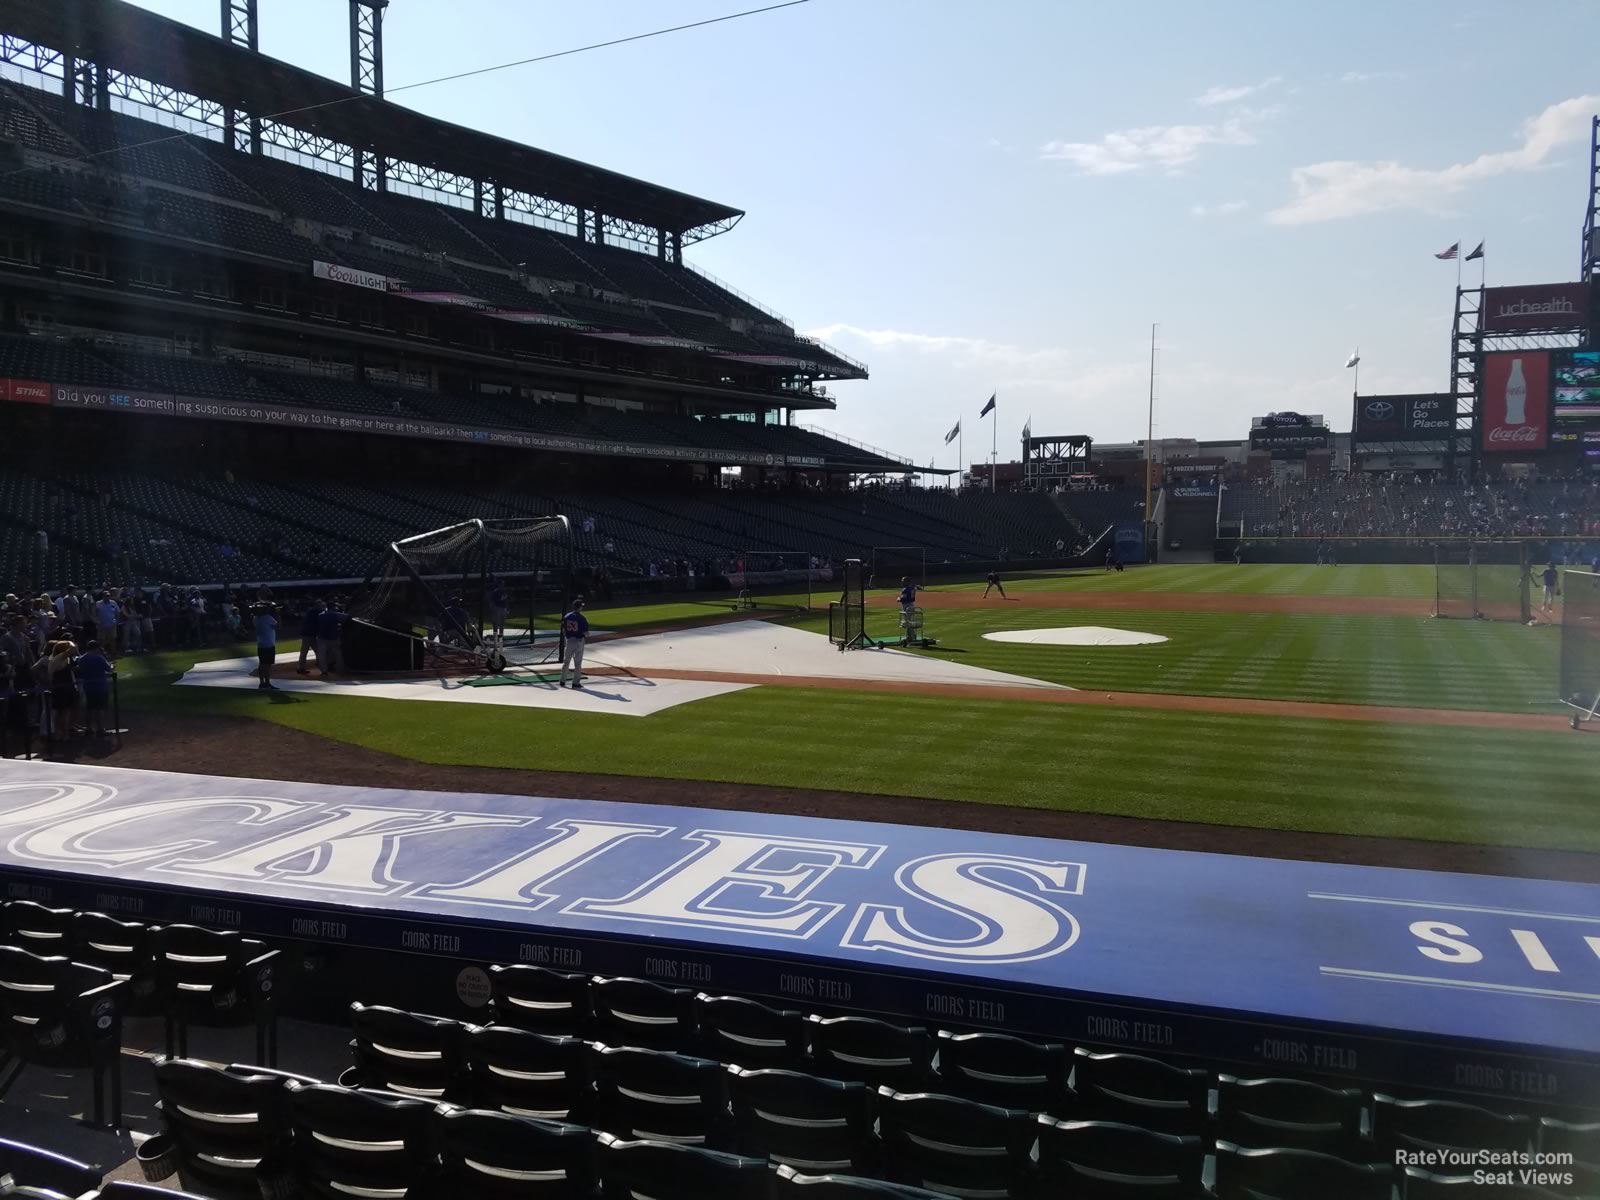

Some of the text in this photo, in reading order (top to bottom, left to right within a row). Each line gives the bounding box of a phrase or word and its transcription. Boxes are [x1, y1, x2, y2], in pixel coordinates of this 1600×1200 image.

[327, 264, 386, 290] Coors LIGHT
[1500, 296, 1573, 315] uchealth
[16, 387, 46, 397] STIHL
[1412, 410, 1428, 419] Go
[1413, 400, 1439, 410] Let's
[58, 389, 78, 402] Did
[83, 394, 105, 405] you
[110, 393, 130, 406] SEE
[134, 398, 192, 413] something
[195, 404, 247, 417] suspicious
[250, 409, 262, 418] on
[265, 410, 286, 421] your
[290, 413, 309, 424] way
[312, 414, 320, 424] to
[323, 415, 338, 425] the
[340, 417, 362, 428] game
[364, 420, 373, 428] or
[376, 421, 394, 431] here
[396, 423, 404, 432] at
[406, 424, 419, 433] the
[421, 424, 455, 437] ballpark?
[456, 428, 473, 438] Then
[490, 432, 523, 445] something
[532, 436, 546, 446] local
[548, 438, 578, 450] authorities
[1273, 416, 1297, 424] TOYOTA
[1412, 419, 1450, 428] Places
[292, 918, 346, 938] COORS FIELD
[402, 930, 460, 952] COORS FIELD
[1408, 920, 1600, 973] SI
[520, 943, 582, 966] COORS FIELD
[645, 957, 712, 982] COORS FIELD
[780, 973, 851, 1000] COORS FIELD
[926, 992, 1005, 1022] COORS FIELD
[1087, 1015, 1174, 1046] COORS FIELD
[1263, 1038, 1358, 1070] COORS FIELD
[1455, 1063, 1558, 1096] COORS FIELD
